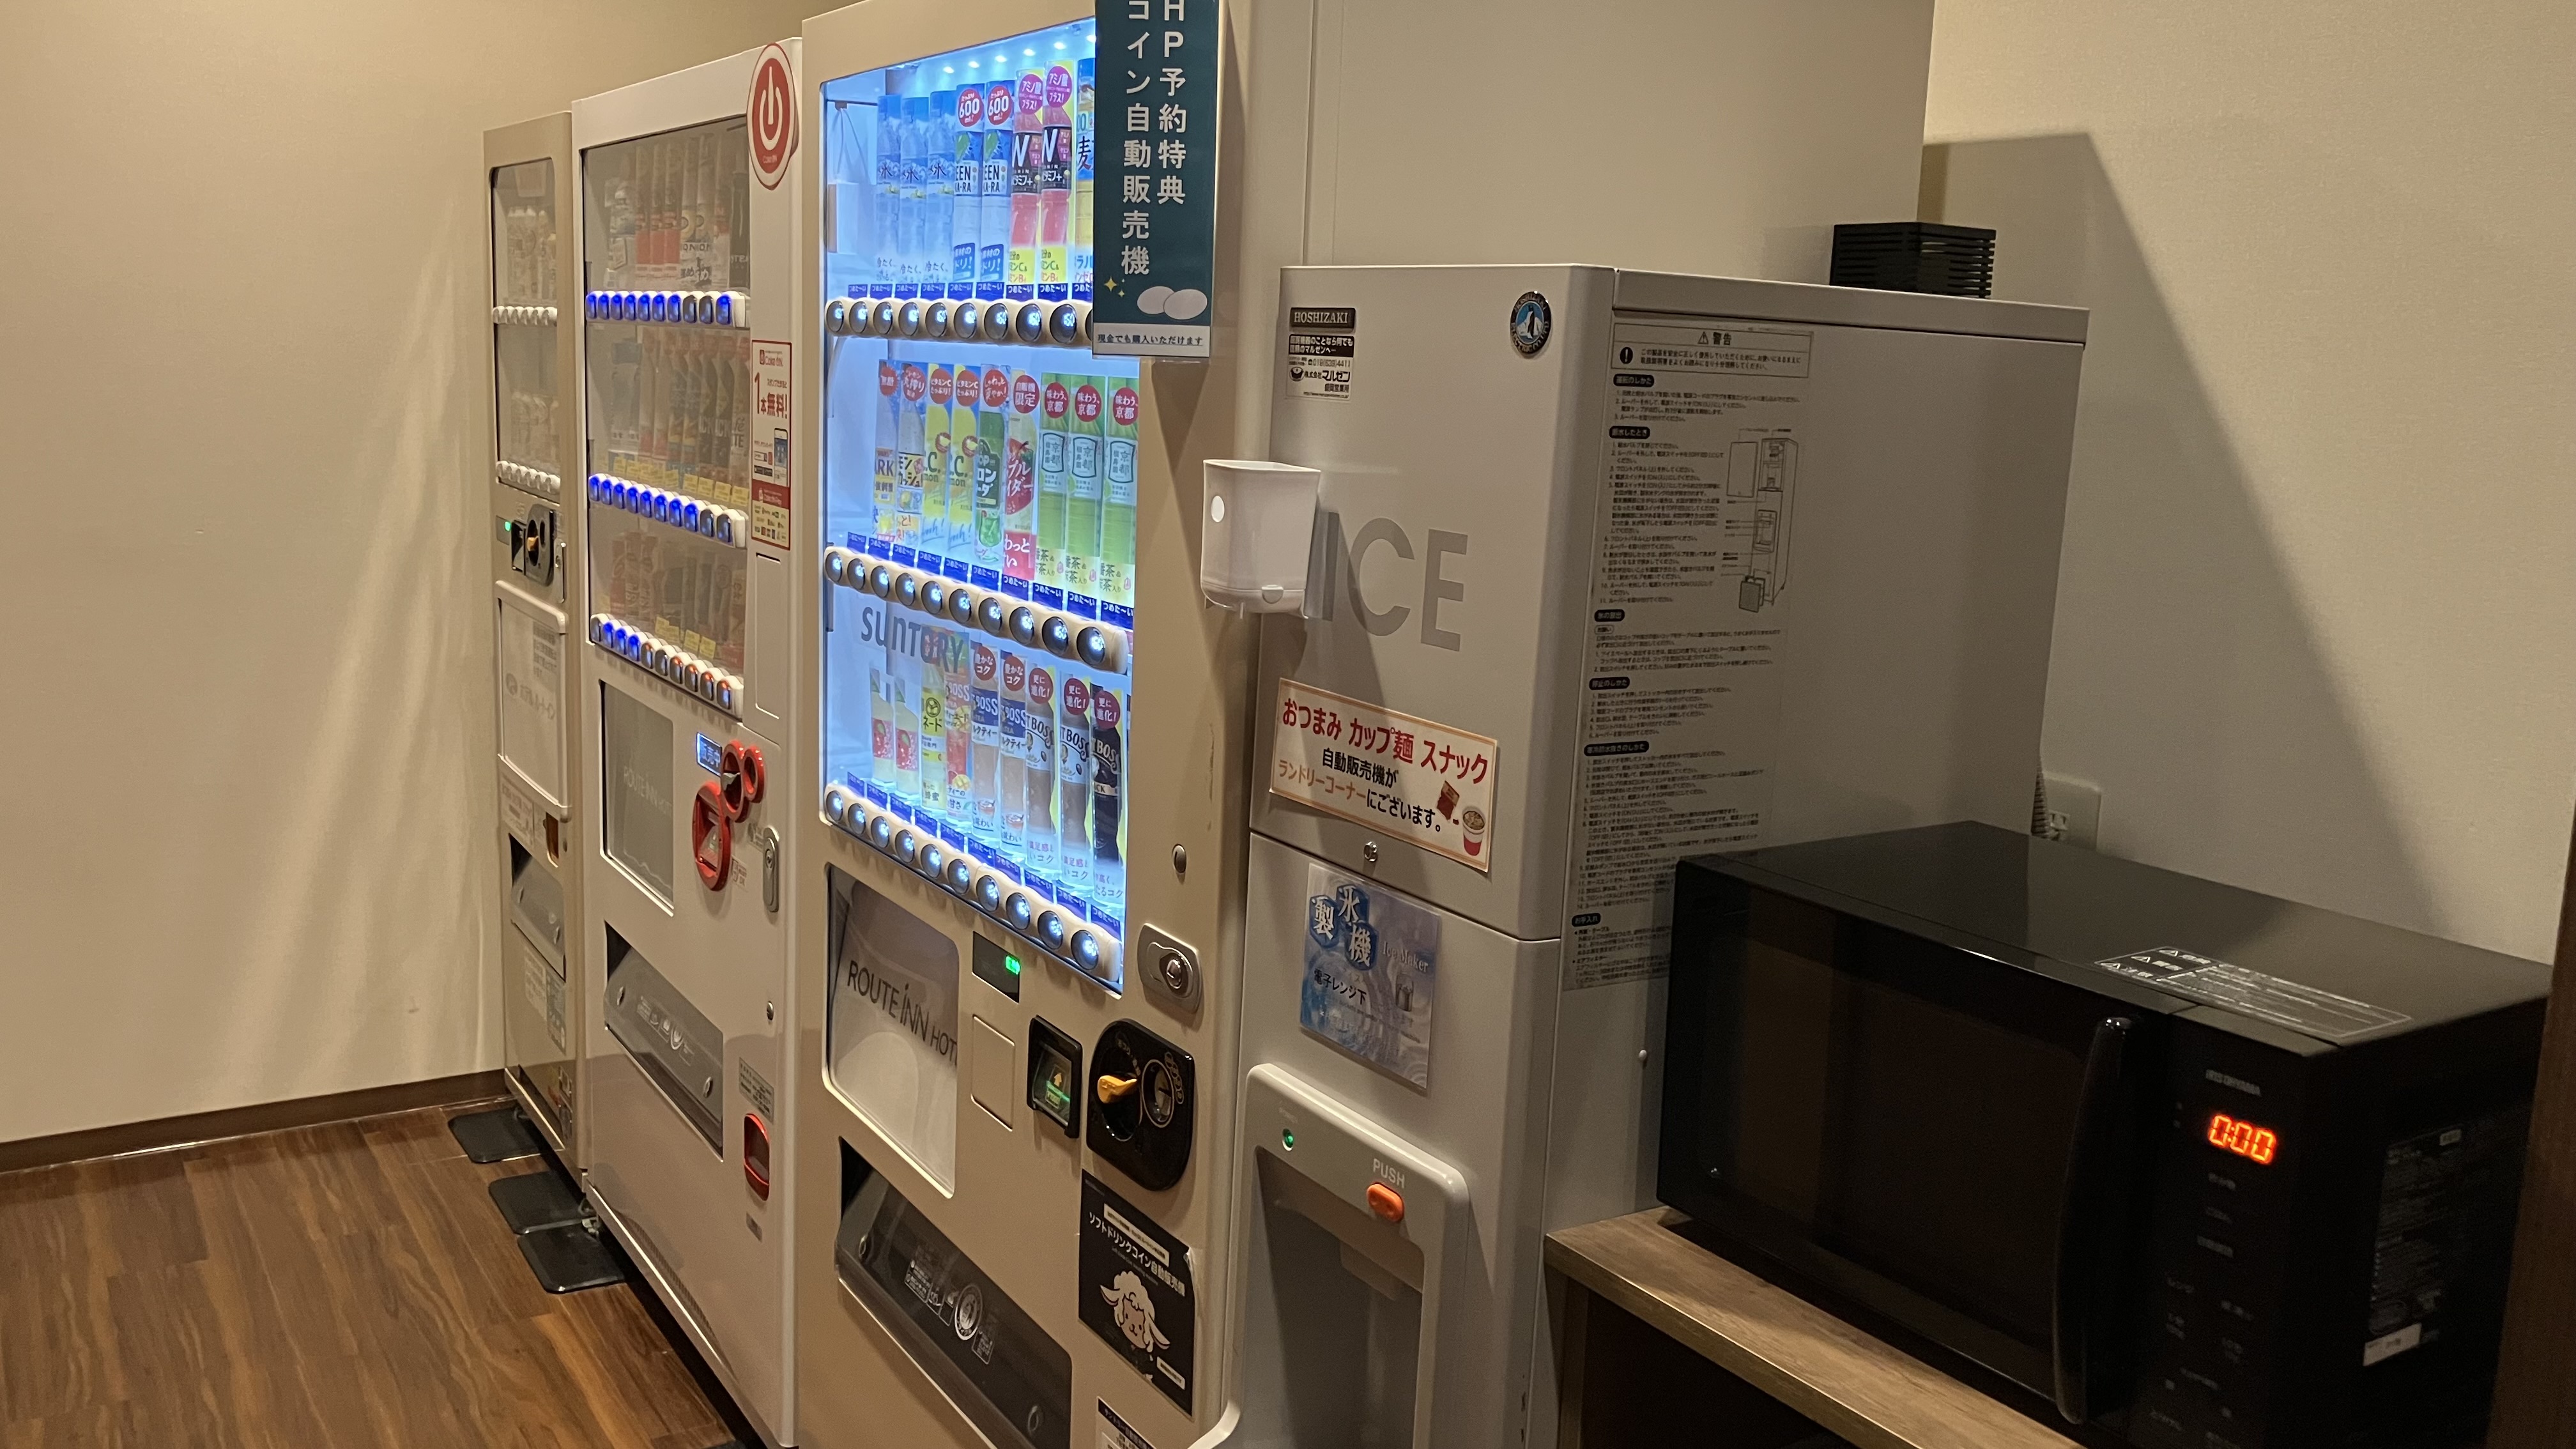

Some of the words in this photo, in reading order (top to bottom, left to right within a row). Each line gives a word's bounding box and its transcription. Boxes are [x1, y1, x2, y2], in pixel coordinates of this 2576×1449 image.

[958, 97, 980, 118] 600
[988, 95, 1009, 116] 600
[1157, 0, 1186, 204] HP予約特典
[1294, 311, 1349, 324] HOSHIZAKI
[1097, 333, 1203, 347] 現金でも購入いただけます
[1712, 331, 1733, 346] 警告
[1015, 392, 1036, 408] 限定
[1046, 400, 1064, 413] 京都
[1077, 403, 1097, 417] 京都
[1115, 406, 1135, 420] 京都
[1322, 510, 1469, 652] ICE
[1282, 697, 1342, 741] おつまみ
[1348, 717, 1414, 765] カップ麺
[1420, 739, 1489, 785] スナック
[1322, 747, 1399, 790] 自動販売機が
[1278, 759, 1441, 832] ランドリーコーナーにございます。
[847, 960, 900, 1019] ROUTE
[1314, 967, 1367, 1006] 電子レンジ下
[2209, 1115, 2275, 1162] 0:00
[1373, 1158, 1405, 1189] PUSH
